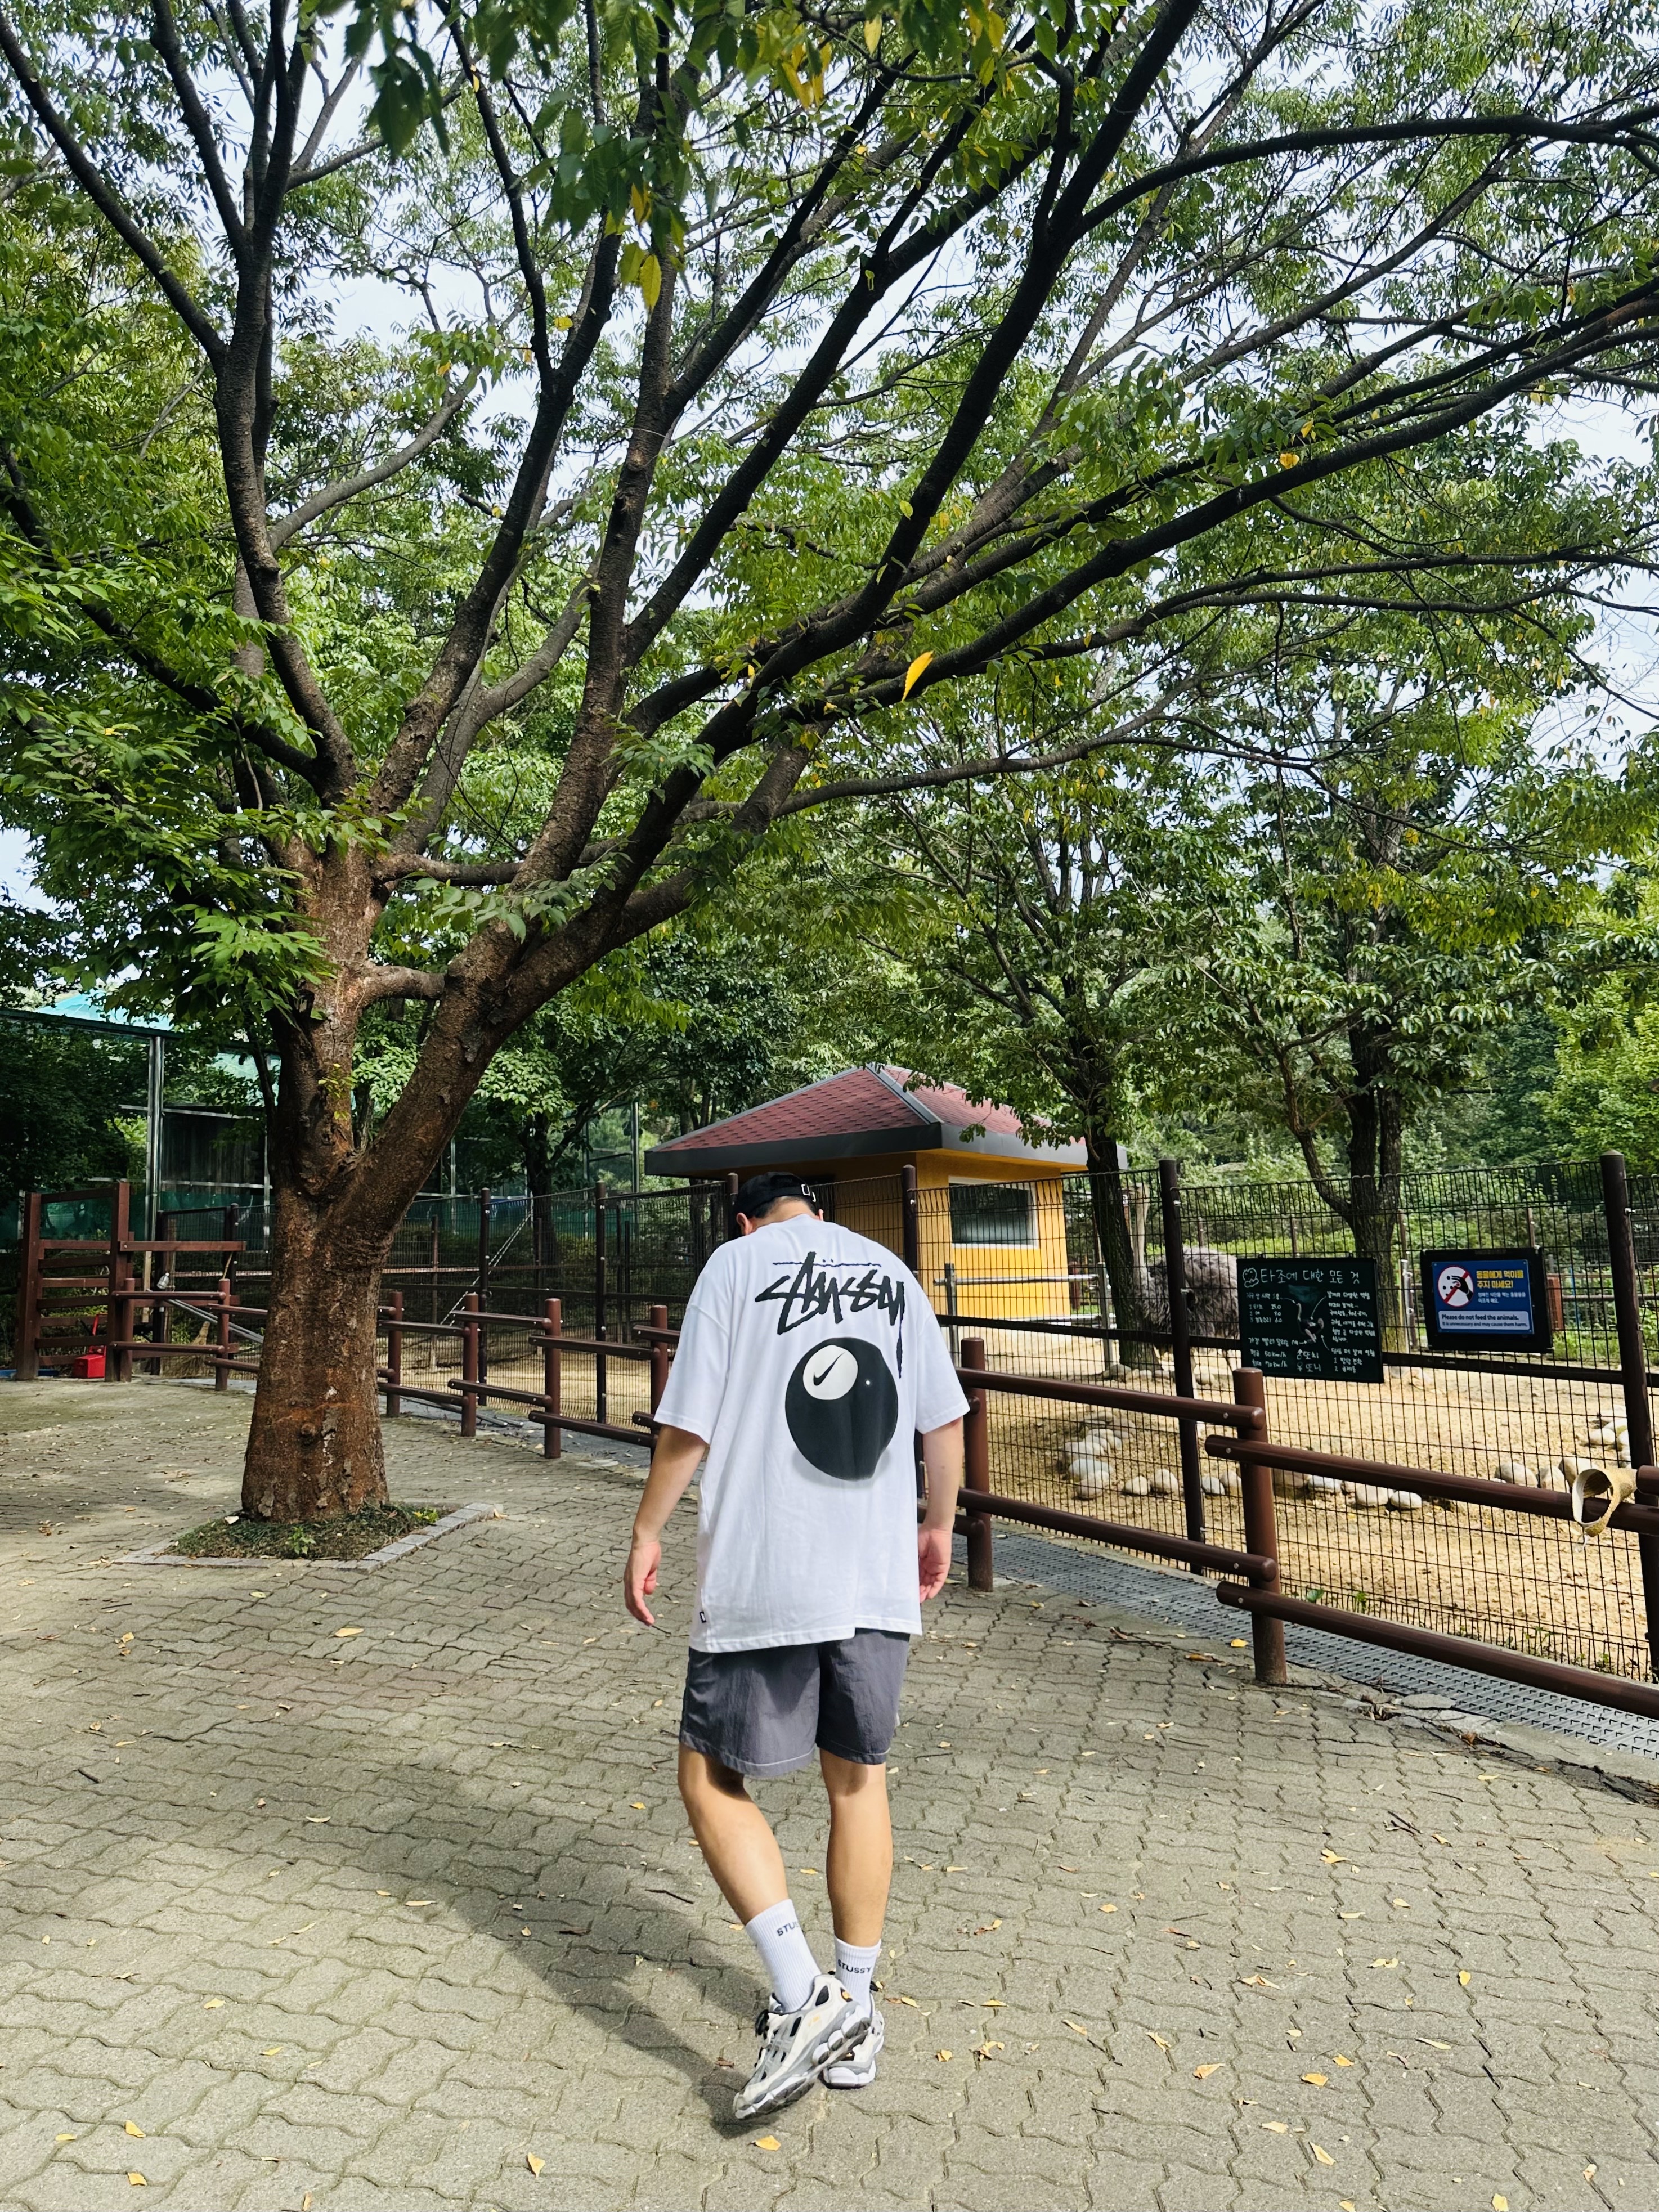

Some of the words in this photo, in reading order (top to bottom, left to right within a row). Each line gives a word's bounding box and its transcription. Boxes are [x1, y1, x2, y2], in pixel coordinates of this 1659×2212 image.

[1260, 1268, 1298, 1283] 타조에
[1303, 1268, 1324, 1282] 대한
[1329, 1269, 1344, 1283] 모든
[1350, 1271, 1360, 1284] 것
[1476, 1270, 1503, 1279] 동물에게
[1503, 1269, 1524, 1279] 먹이를
[1477, 1280, 1490, 1289] 주지
[1491, 1280, 1513, 1289] 마세요!
[1248, 1337, 1260, 1345] 가장
[1262, 1338, 1275, 1346] 빨리
[1305, 1363, 1321, 1372] 또니
[837, 1959, 872, 1974] STUSSY
